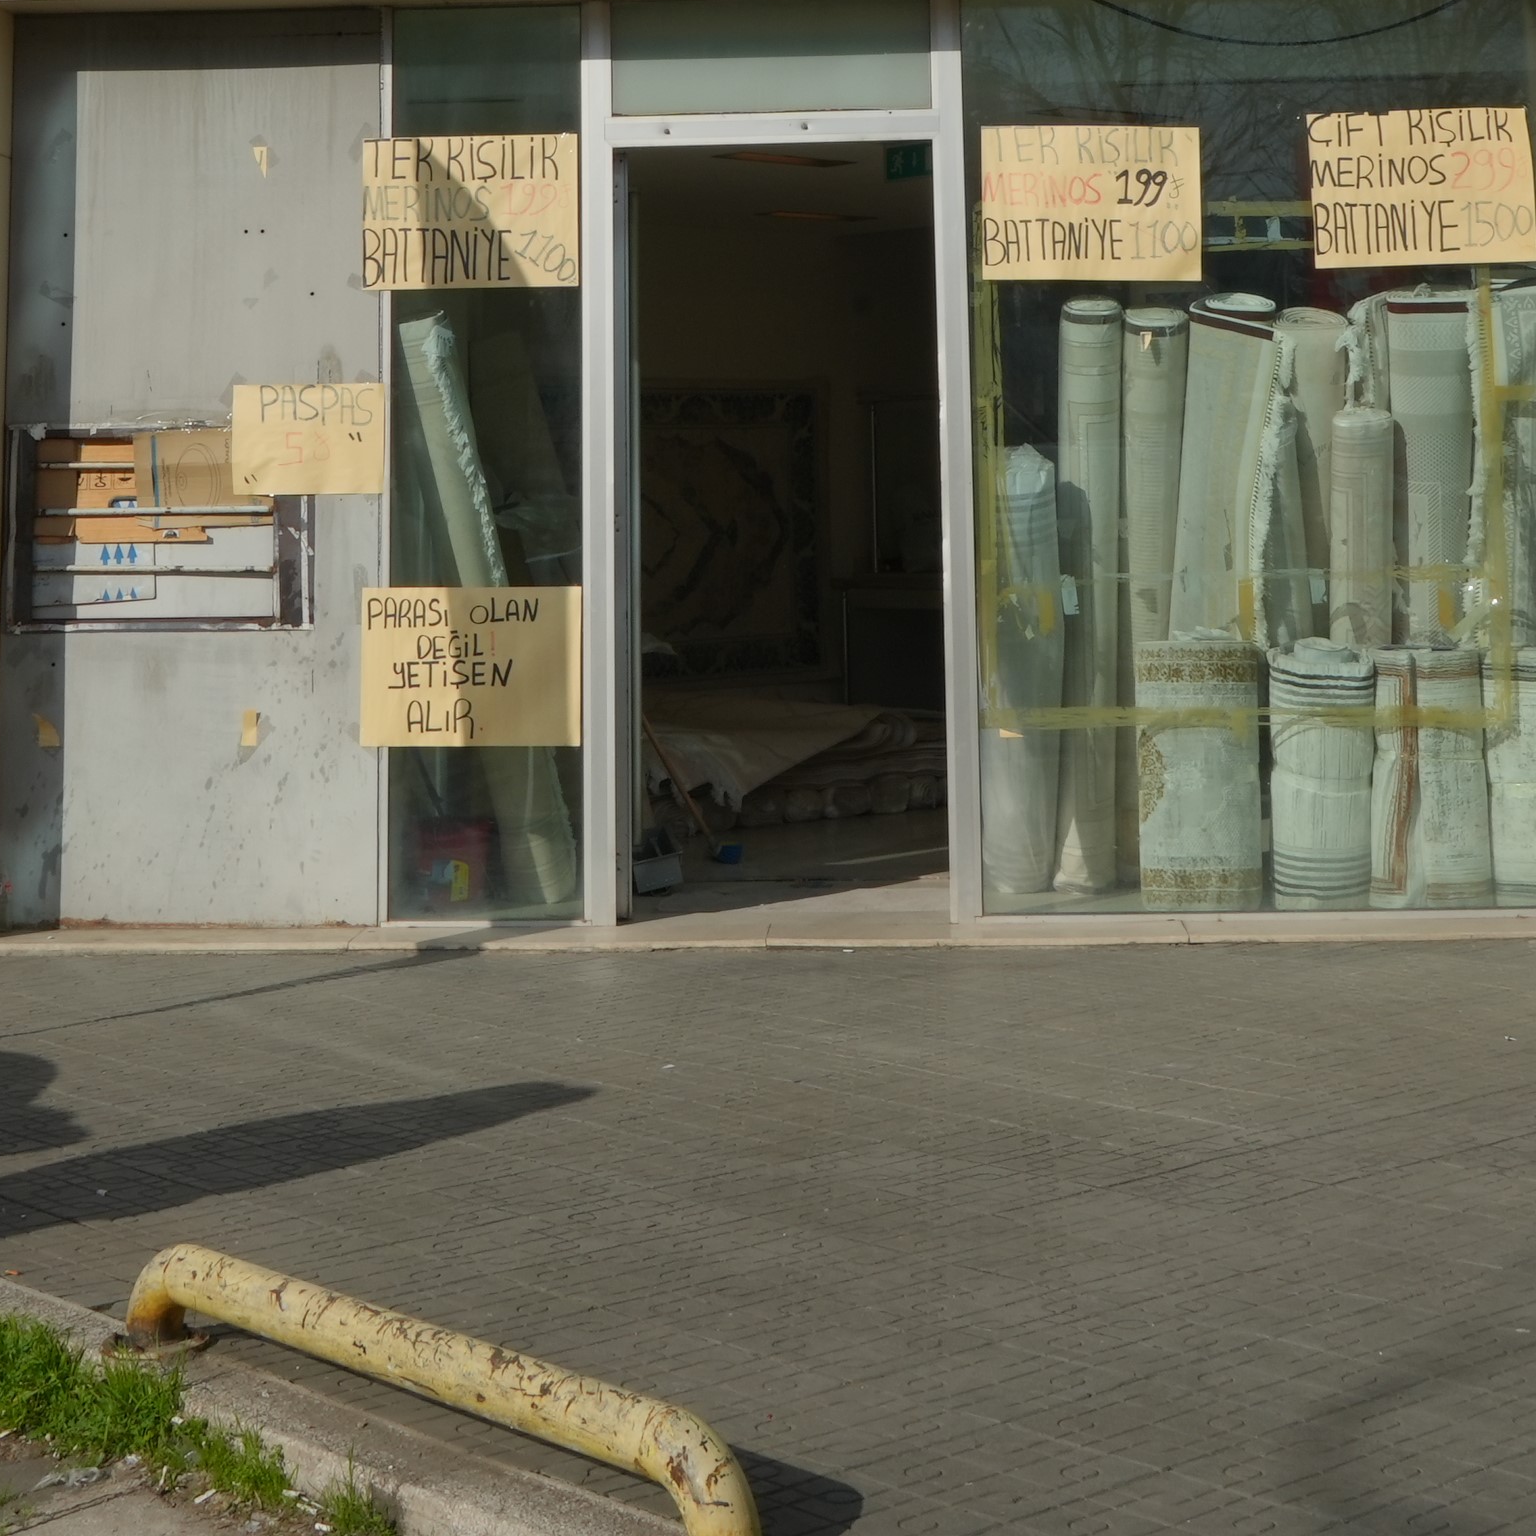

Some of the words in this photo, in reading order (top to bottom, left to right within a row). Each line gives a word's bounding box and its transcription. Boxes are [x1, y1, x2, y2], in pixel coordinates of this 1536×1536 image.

[981, 125, 1059, 165] TEK
[1076, 127, 1179, 167] KİŞİLİK
[1307, 112, 1390, 147] ÇİFT
[1406, 108, 1513, 147] KİŞİLİK
[363, 138, 434, 182] TEK
[446, 136, 559, 183] KİŞİLİK
[1310, 153, 1447, 190] MERİNOS
[363, 184, 493, 223] MERİNOS
[981, 172, 1105, 208] MERİNOS
[982, 217, 1123, 267] BATTANİYE
[1129, 219, 1199, 260] 1100
[1313, 200, 1461, 256] BATTANİYE
[1460, 201, 1534, 248] 1500
[362, 227, 512, 288] BATTANİYE
[260, 384, 374, 426] PASPAS
[469, 597, 539, 625] OLAN
[388, 659, 513, 690] YETİŞEN
